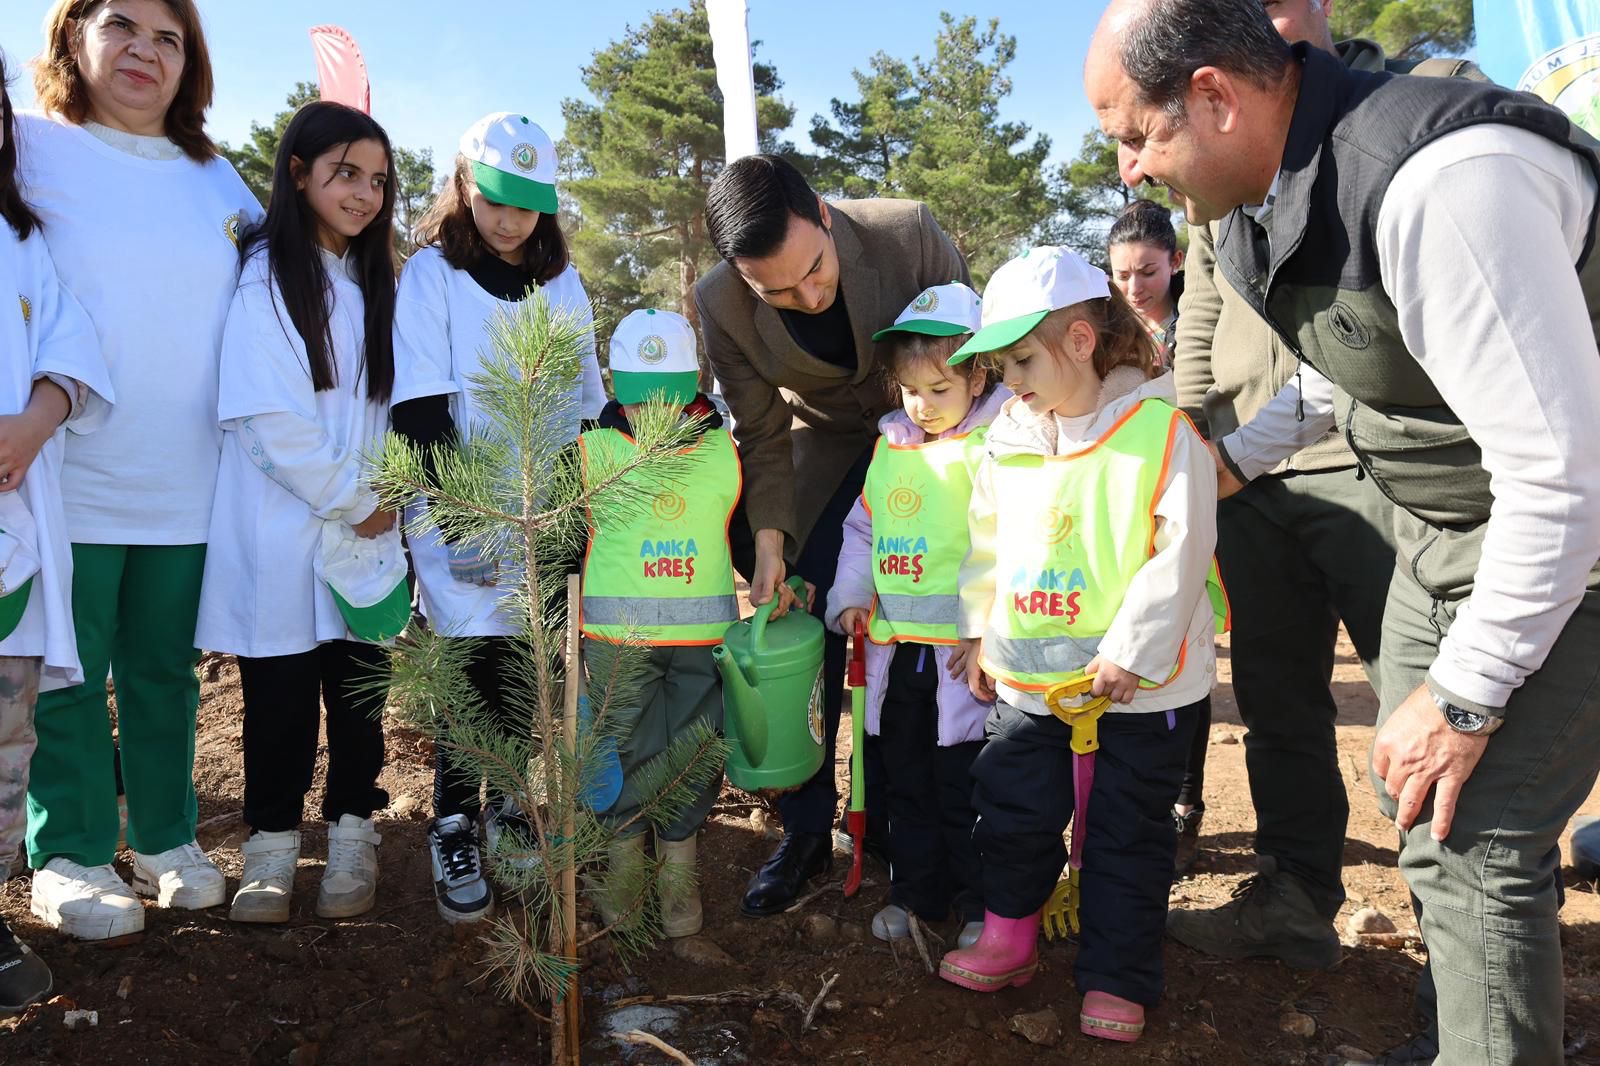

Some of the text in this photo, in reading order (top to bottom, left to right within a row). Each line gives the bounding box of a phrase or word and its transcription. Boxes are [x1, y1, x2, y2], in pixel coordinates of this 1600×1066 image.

[640, 538, 698, 557] ANKA
[877, 536, 928, 554] ANKA
[644, 557, 695, 584] KREŞ
[879, 554, 923, 583] KREŞ
[1010, 567, 1087, 591] ANKA
[1014, 591, 1081, 625] KREŞ
